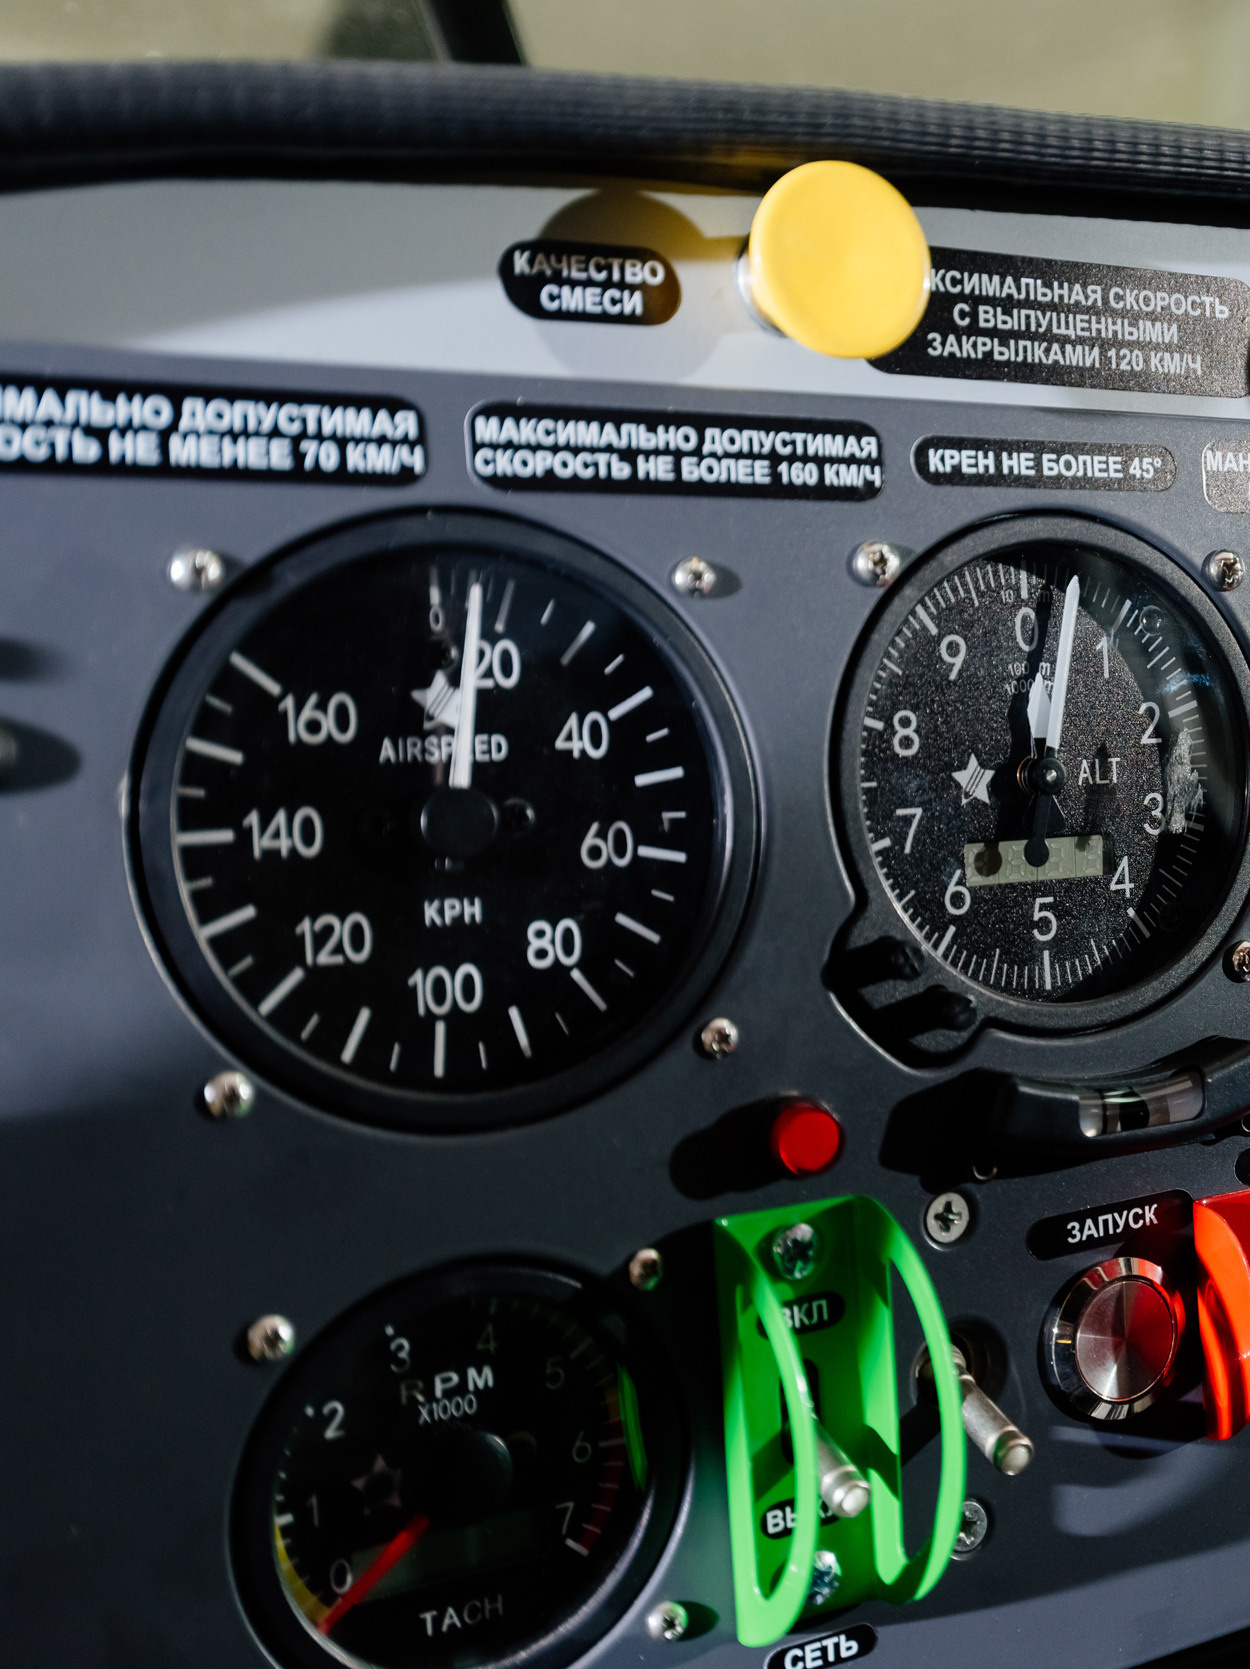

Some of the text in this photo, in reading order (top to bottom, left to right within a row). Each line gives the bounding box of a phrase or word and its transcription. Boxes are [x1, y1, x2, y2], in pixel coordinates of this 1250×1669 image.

[512, 250, 667, 287] КАЧЕСТВО
[539, 284, 644, 318] СМЕСИ
[930, 267, 1230, 319] КСИМАЛЬНАЯ СКОРОСТЬ
[952, 302, 1178, 344] С ВЫПУЩЕННЫМИ
[926, 331, 1202, 377] ЗАКРЫЛКАМИ 120 КМ/Ч
[0, 383, 420, 442] МАЛЬНО ДОПУСТИМАЯ
[0, 421, 425, 476] ОСТЬ НЕ МЕНЕЕ 70 КМ/Ч
[473, 414, 879, 460] МАКСИМАЛЬНО ДОПУСТИМАЯ
[473, 447, 882, 488] СКОРОСТЬ НЕ БОЛЕЕ 160 КМ/Ч
[927, 448, 1163, 480] КРЕН НЕ БОЛЕЕ 45°
[428, 605, 446, 631] 0
[1015, 606, 1039, 652] 0
[939, 633, 967, 682] 9
[1095, 634, 1111, 679] 1
[277, 691, 358, 746] 160
[554, 710, 610, 760] 40
[892, 709, 920, 757] 8
[1138, 700, 1163, 745] 2
[378, 733, 510, 764] AIRSPED
[1078, 757, 1121, 786] ALT
[242, 805, 324, 861] 140
[895, 807, 924, 854] 7
[1142, 792, 1167, 836] 3
[579, 819, 635, 869] 60
[944, 869, 972, 916] 6
[1109, 855, 1135, 898] 4
[423, 897, 483, 927] KPH
[1032, 896, 1058, 942] 5
[294, 911, 373, 967] 120
[526, 917, 583, 970] 80
[407, 962, 484, 1018] 100
[1065, 1202, 1160, 1244] ЗАПУСК
[388, 1335, 411, 1374] 3
[476, 1322, 498, 1355] 4
[400, 1364, 495, 1405] RPM
[545, 1356, 565, 1390] 5
[322, 1400, 346, 1441] 2
[572, 1430, 592, 1464] 6
[555, 1500, 575, 1536] 7
[329, 1558, 353, 1595] 0
[418, 1593, 506, 1638] TACH
[783, 1633, 860, 1669] СЕТЬ
